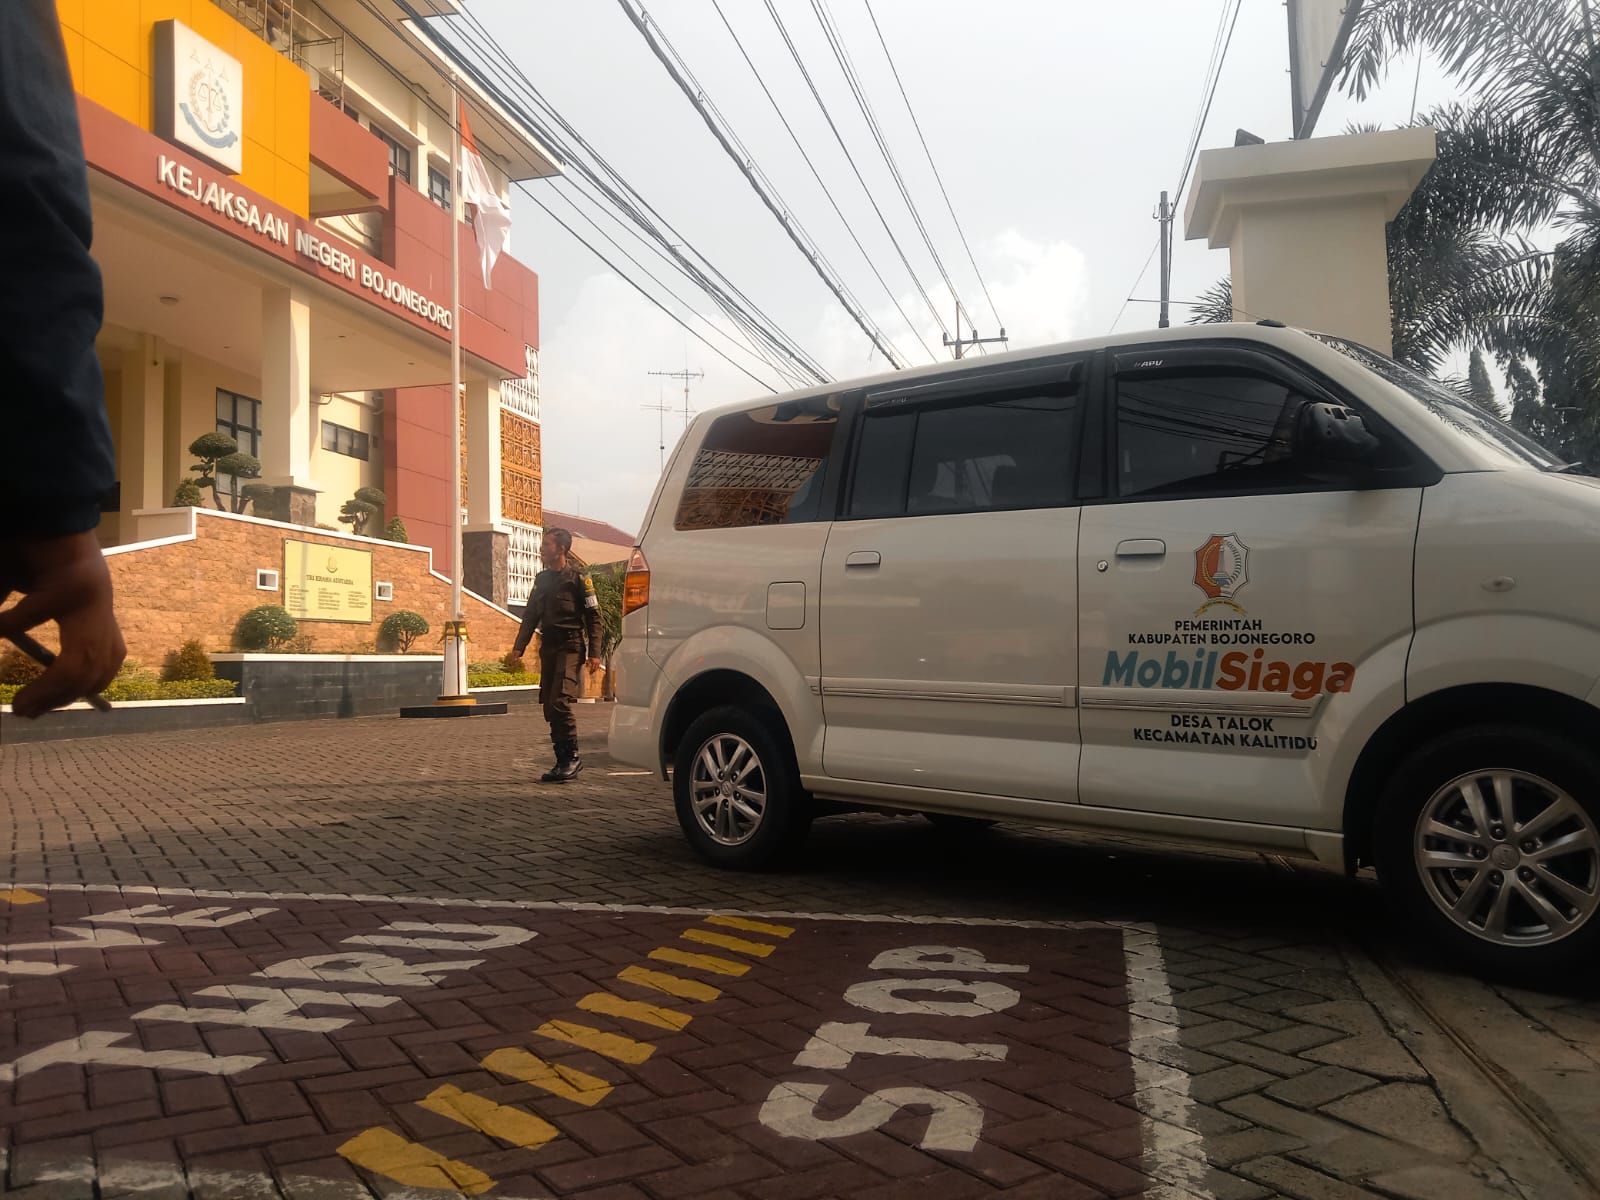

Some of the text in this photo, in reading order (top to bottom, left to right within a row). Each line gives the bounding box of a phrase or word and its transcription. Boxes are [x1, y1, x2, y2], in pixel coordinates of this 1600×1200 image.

[158, 155, 452, 330] KEJAKSAAN NEGERI BOJONEGORO
[1175, 619, 1262, 632] PEMERINTAH
[1128, 632, 1315, 645] KABUPATEN BOJONEGORO
[1171, 714, 1274, 732] DESA TALOK
[1133, 728, 1318, 751] KECAMATAN KALITIDU
[758, 945, 1030, 1152] STOP
